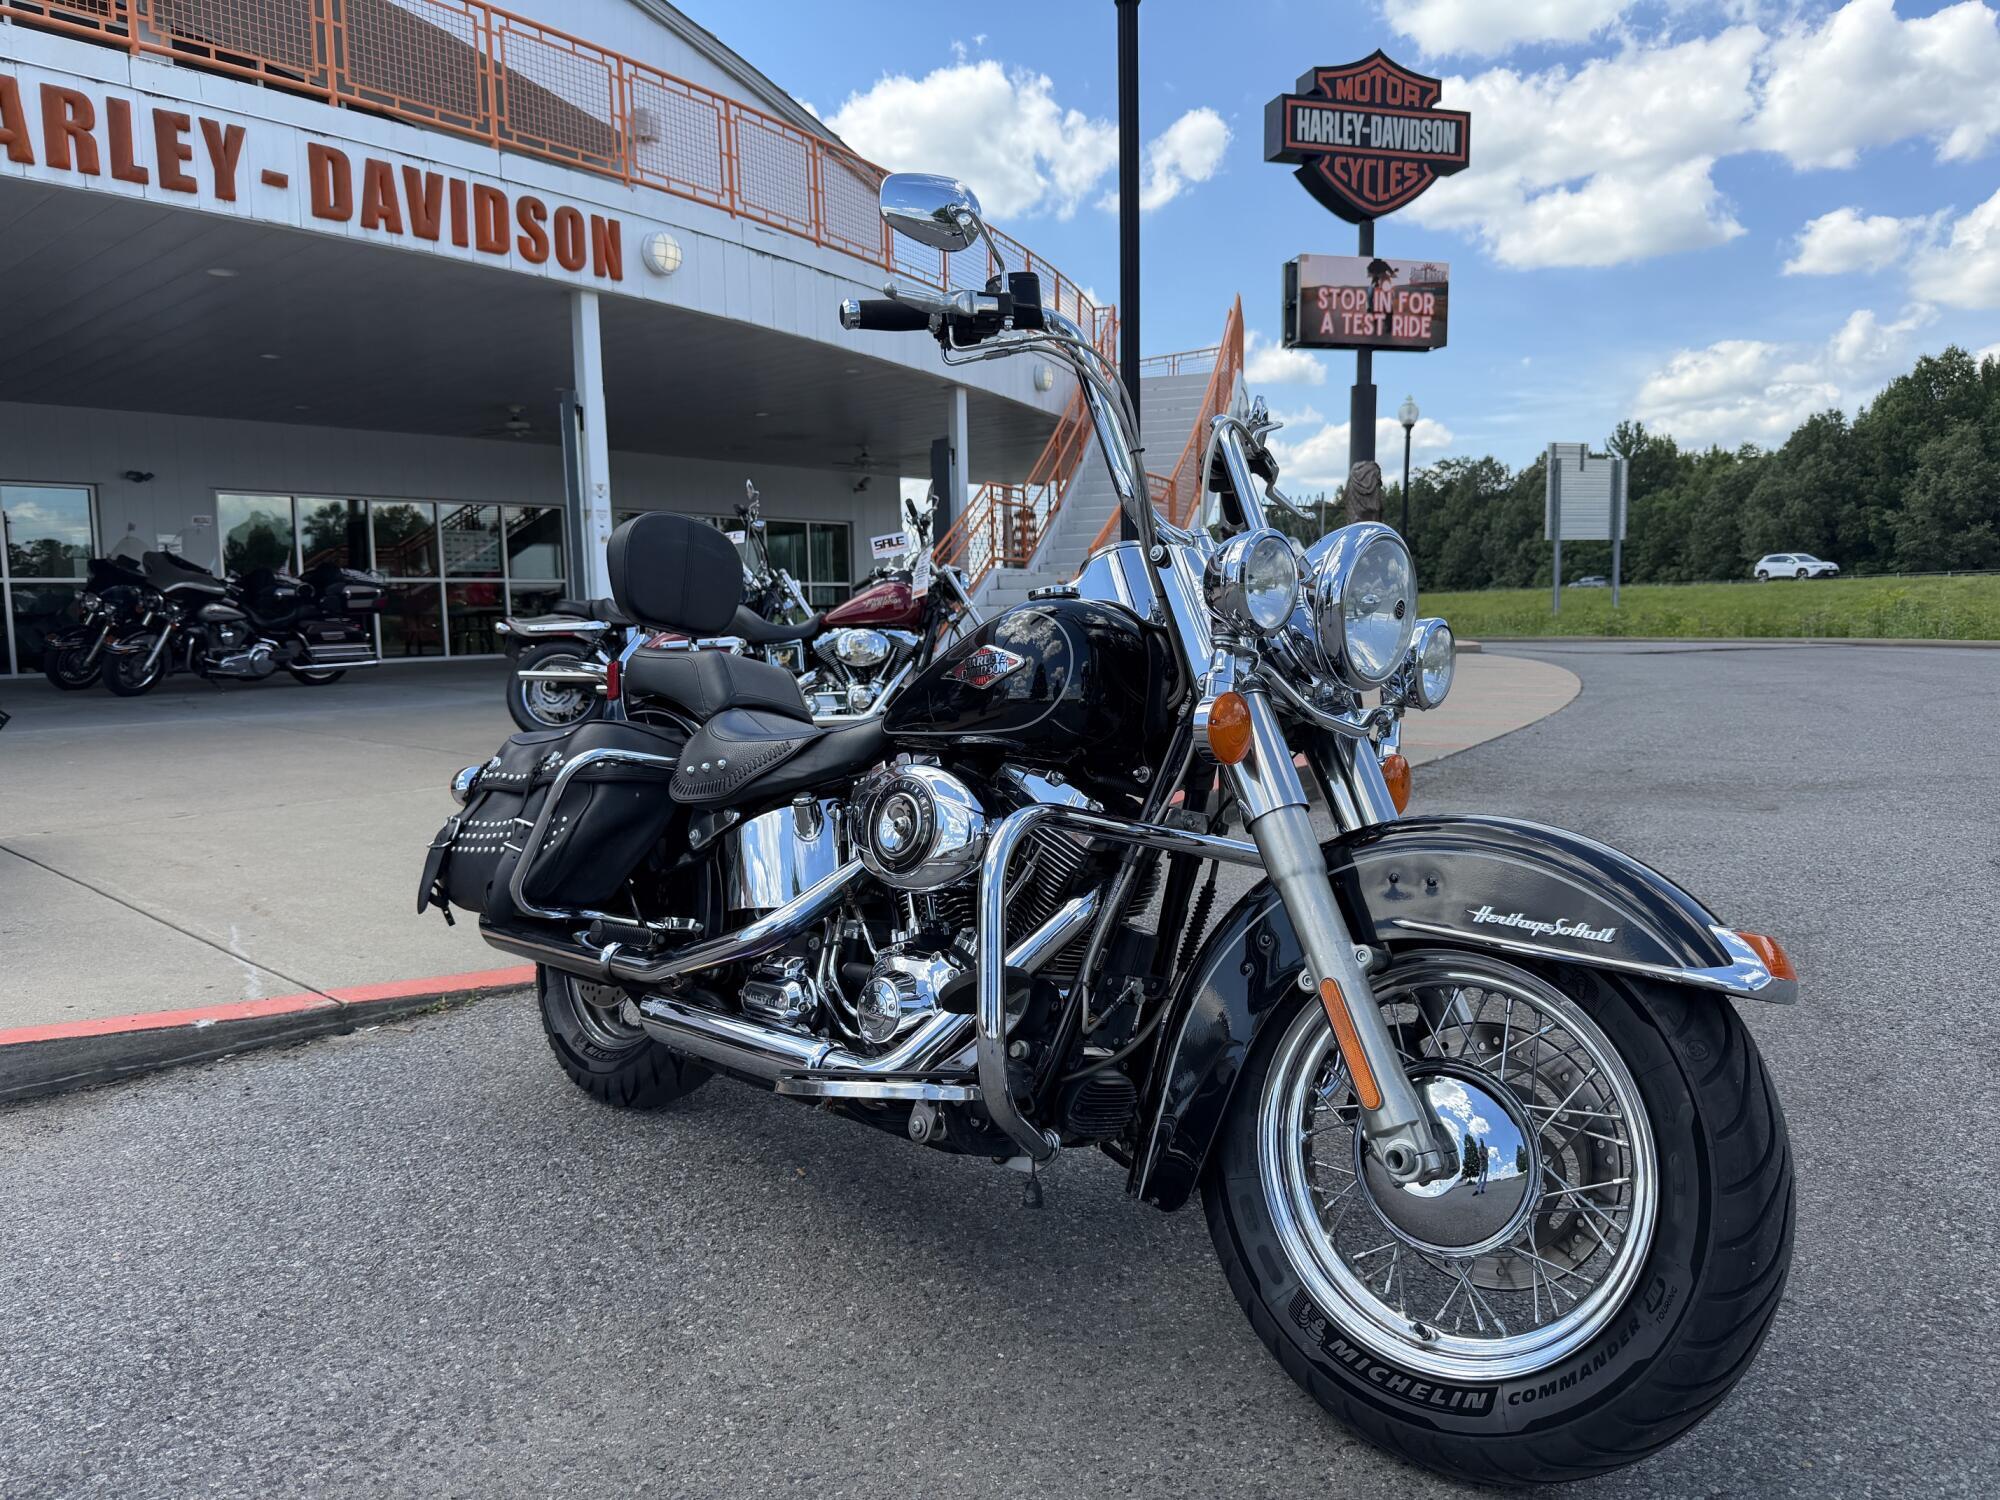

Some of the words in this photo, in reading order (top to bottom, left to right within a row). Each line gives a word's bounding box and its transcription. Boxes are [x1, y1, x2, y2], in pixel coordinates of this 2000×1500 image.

[1336, 66, 1421, 107] MOTOR
[1296, 107, 1456, 154] HARLEY-DAVIDSON
[1334, 156, 1419, 202] CYCLES
[1318, 287, 1367, 310] STOP
[1373, 289, 1392, 313] IN
[1398, 291, 1435, 316] FOR
[1320, 311, 1334, 335] A
[1341, 312, 1386, 336] TEST
[1391, 315, 1432, 339] RIDE
[873, 535, 906, 551] SALE
[1328, 1339, 1488, 1409] MICHELIN
[1508, 1317, 1641, 1406] COMMANDER
